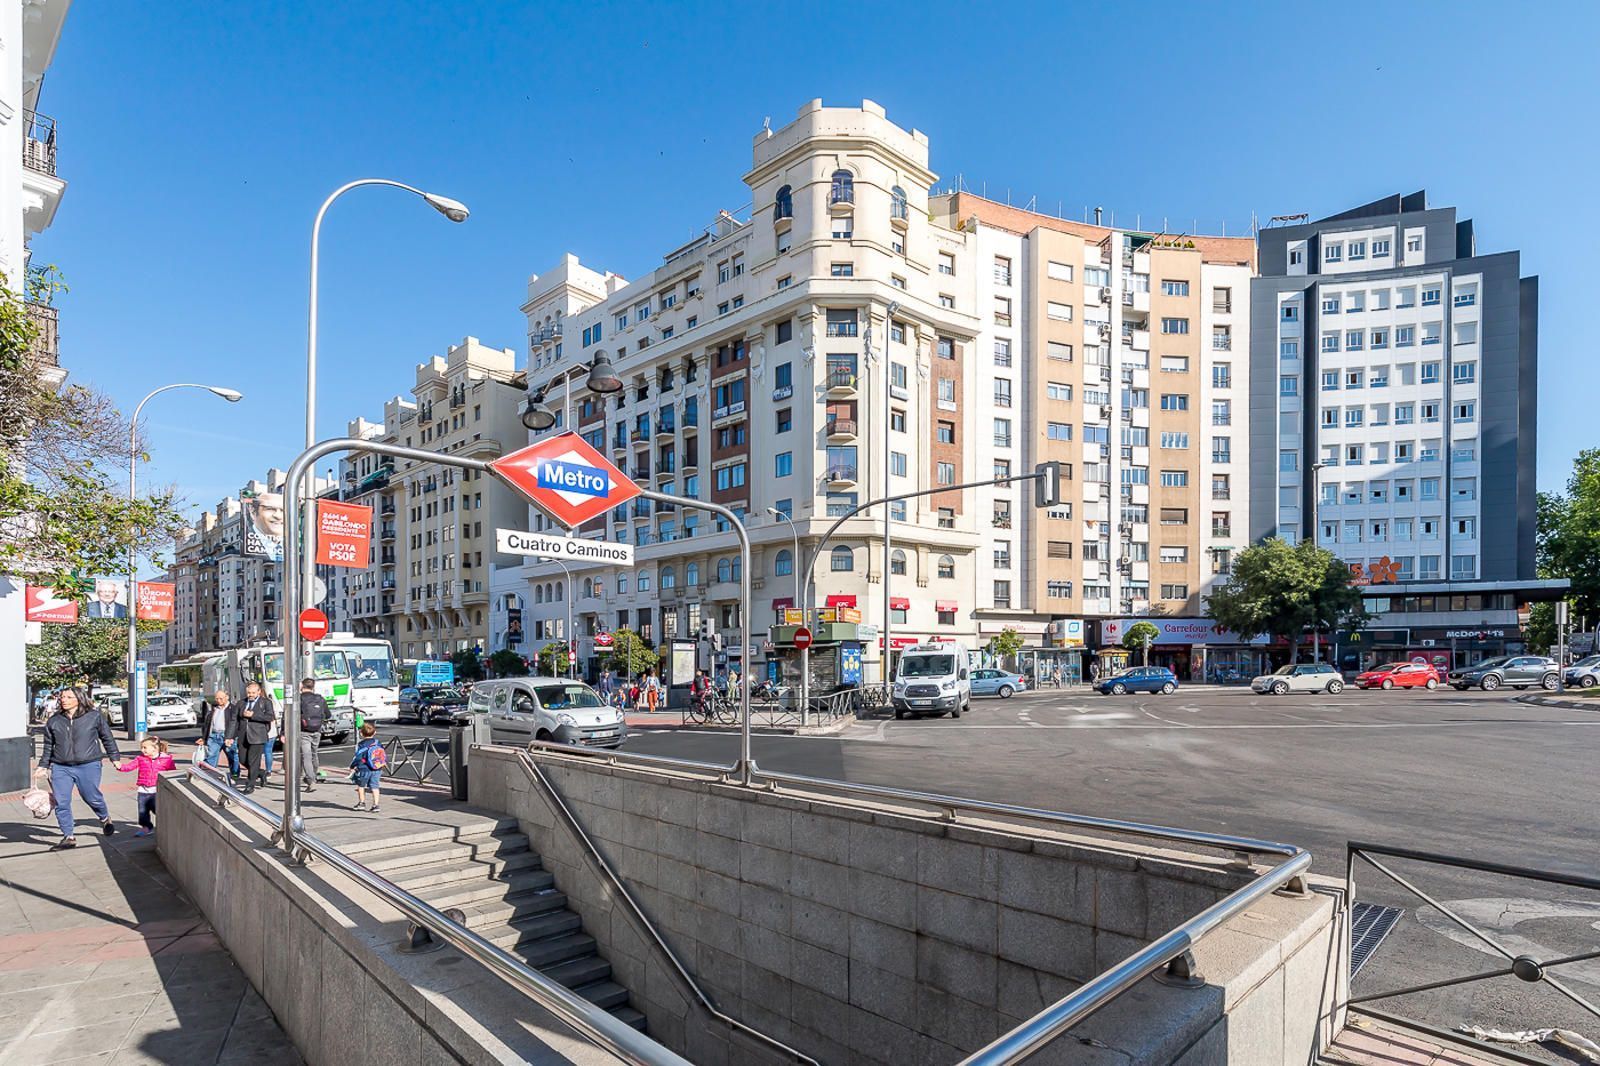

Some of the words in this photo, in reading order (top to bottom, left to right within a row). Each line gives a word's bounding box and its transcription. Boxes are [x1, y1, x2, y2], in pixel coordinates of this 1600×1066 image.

[544, 463, 605, 491] Metro
[322, 519, 367, 530] GABILONDO
[329, 542, 357, 553] VOTA
[507, 534, 561, 553] Cuatro
[566, 541, 628, 561] Caminos
[328, 550, 356, 562] PSOE
[1164, 623, 1208, 633] Carrefour
